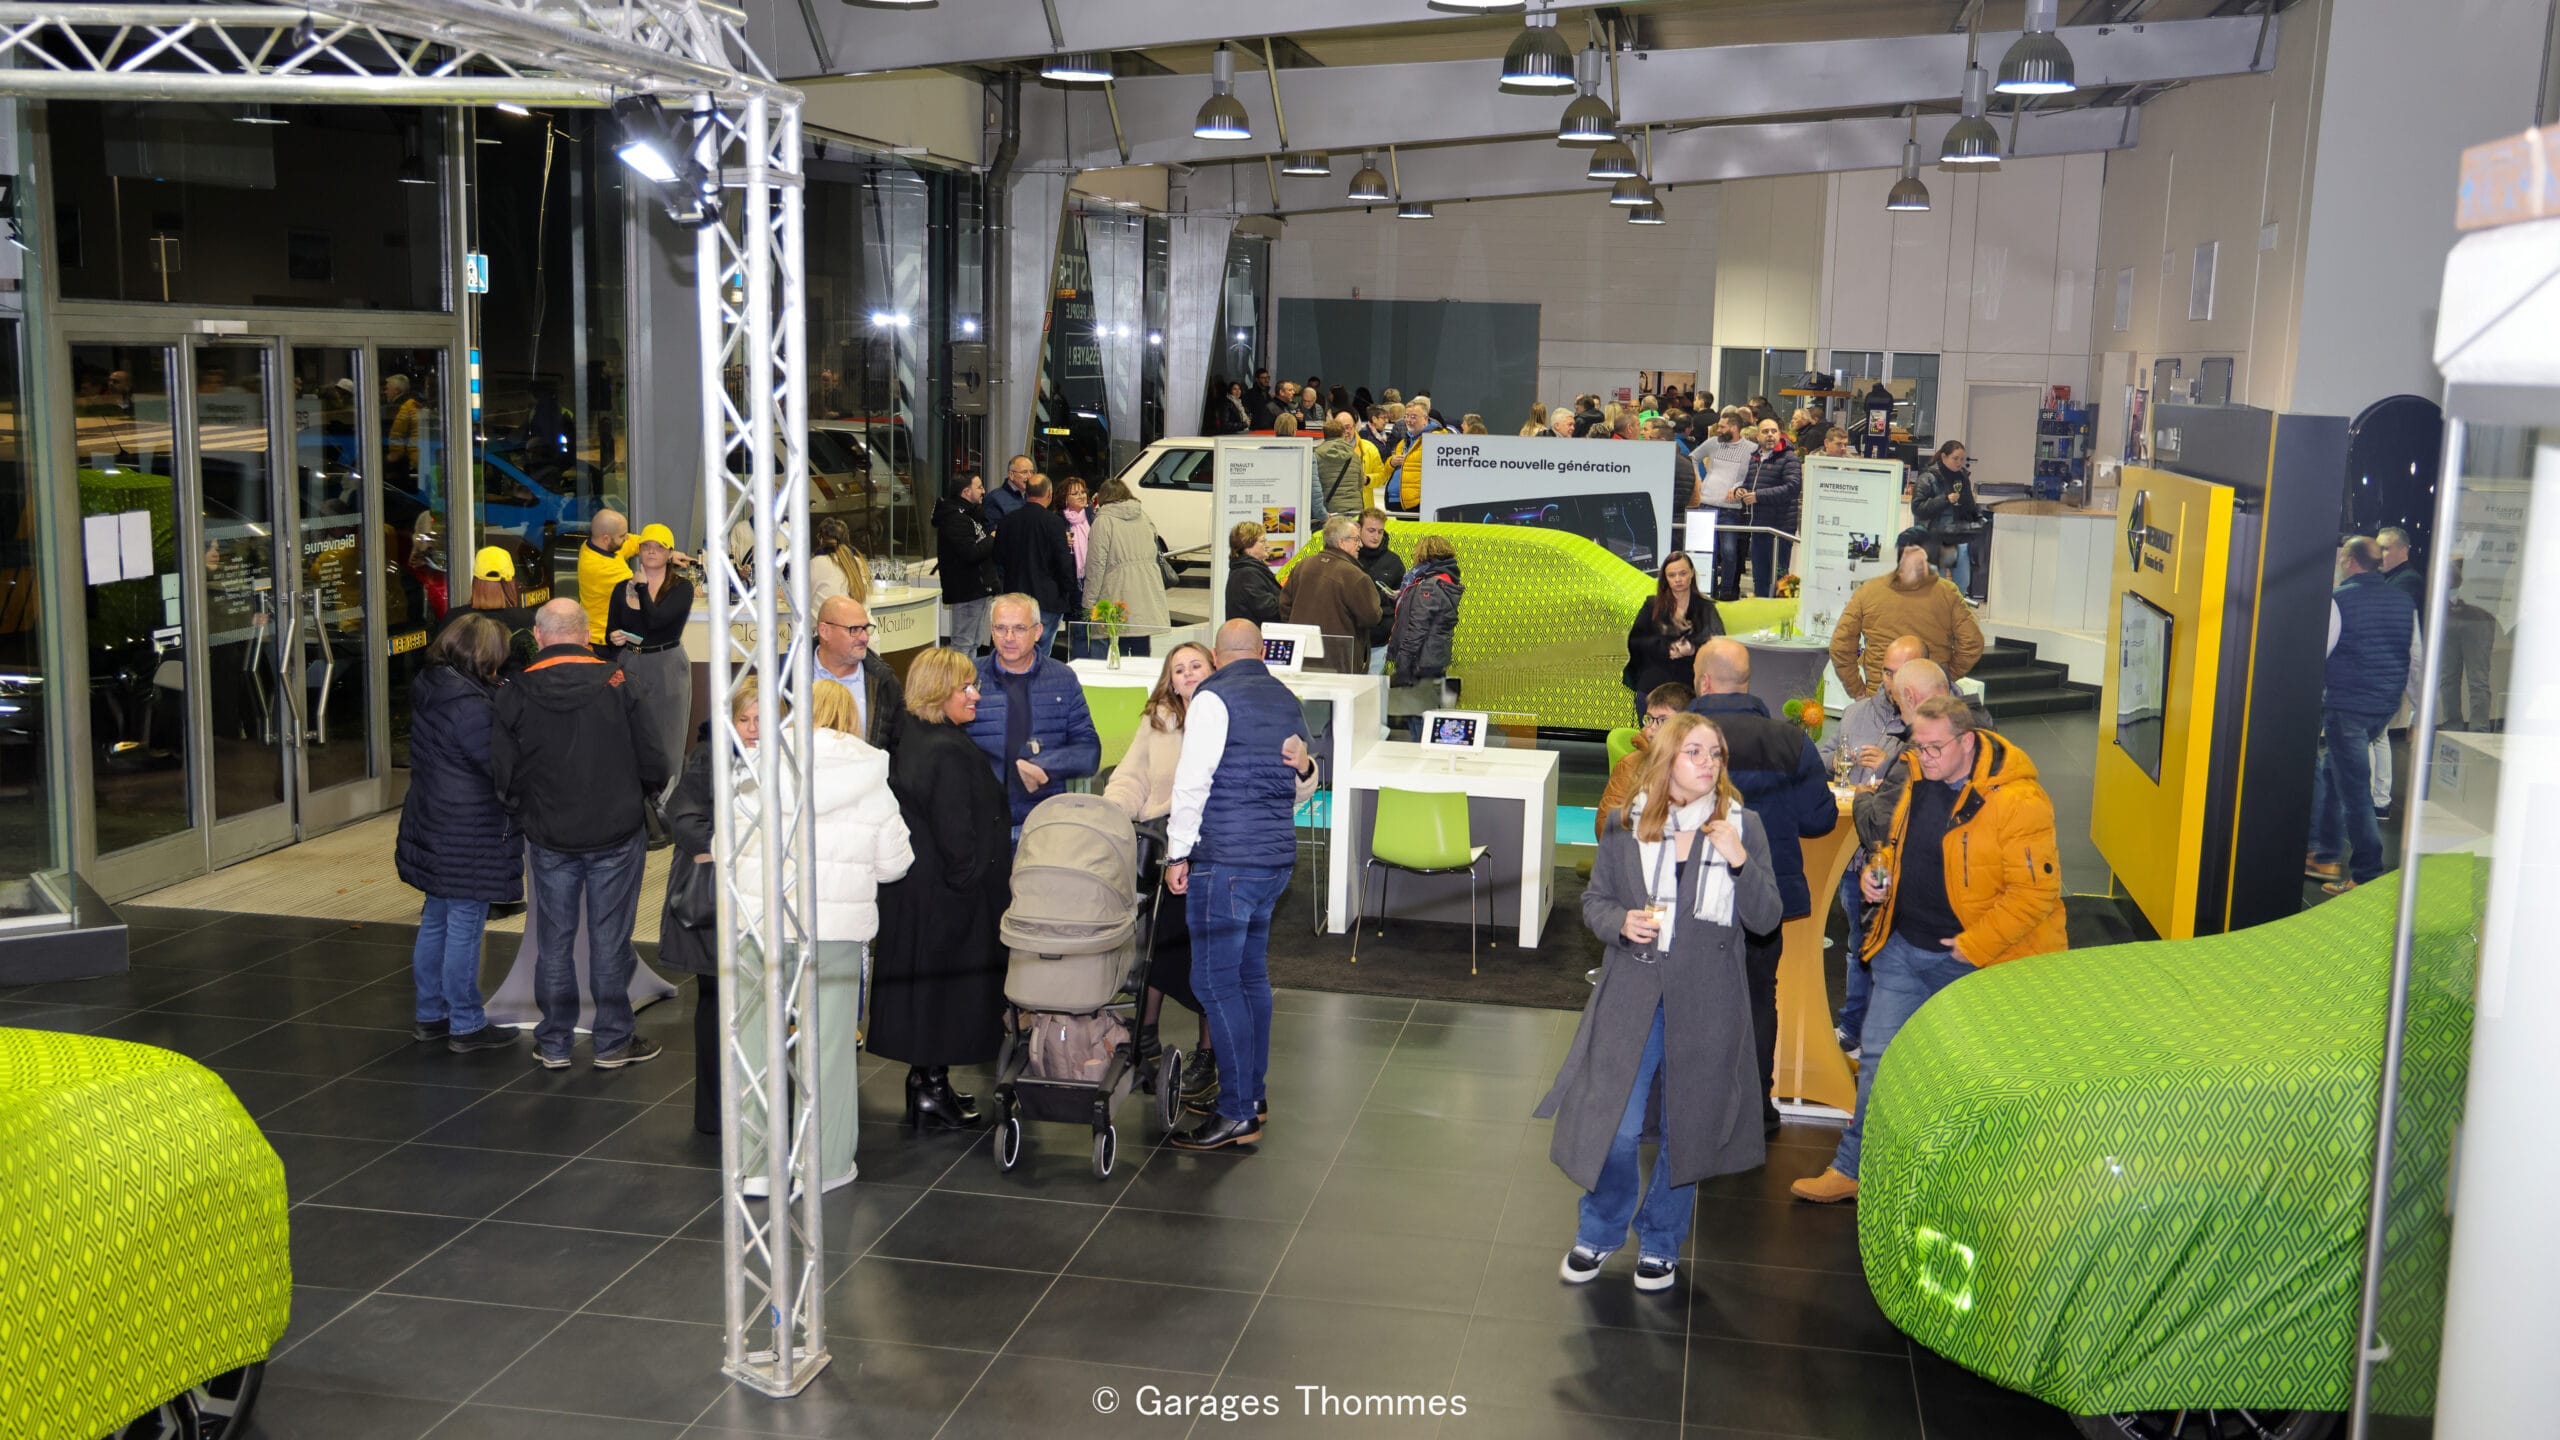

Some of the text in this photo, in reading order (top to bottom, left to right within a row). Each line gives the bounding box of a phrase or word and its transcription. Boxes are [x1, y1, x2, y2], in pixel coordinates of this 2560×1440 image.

[1437, 446, 1480, 457] openR
[1437, 455, 1631, 474] interface nouvelle génération
